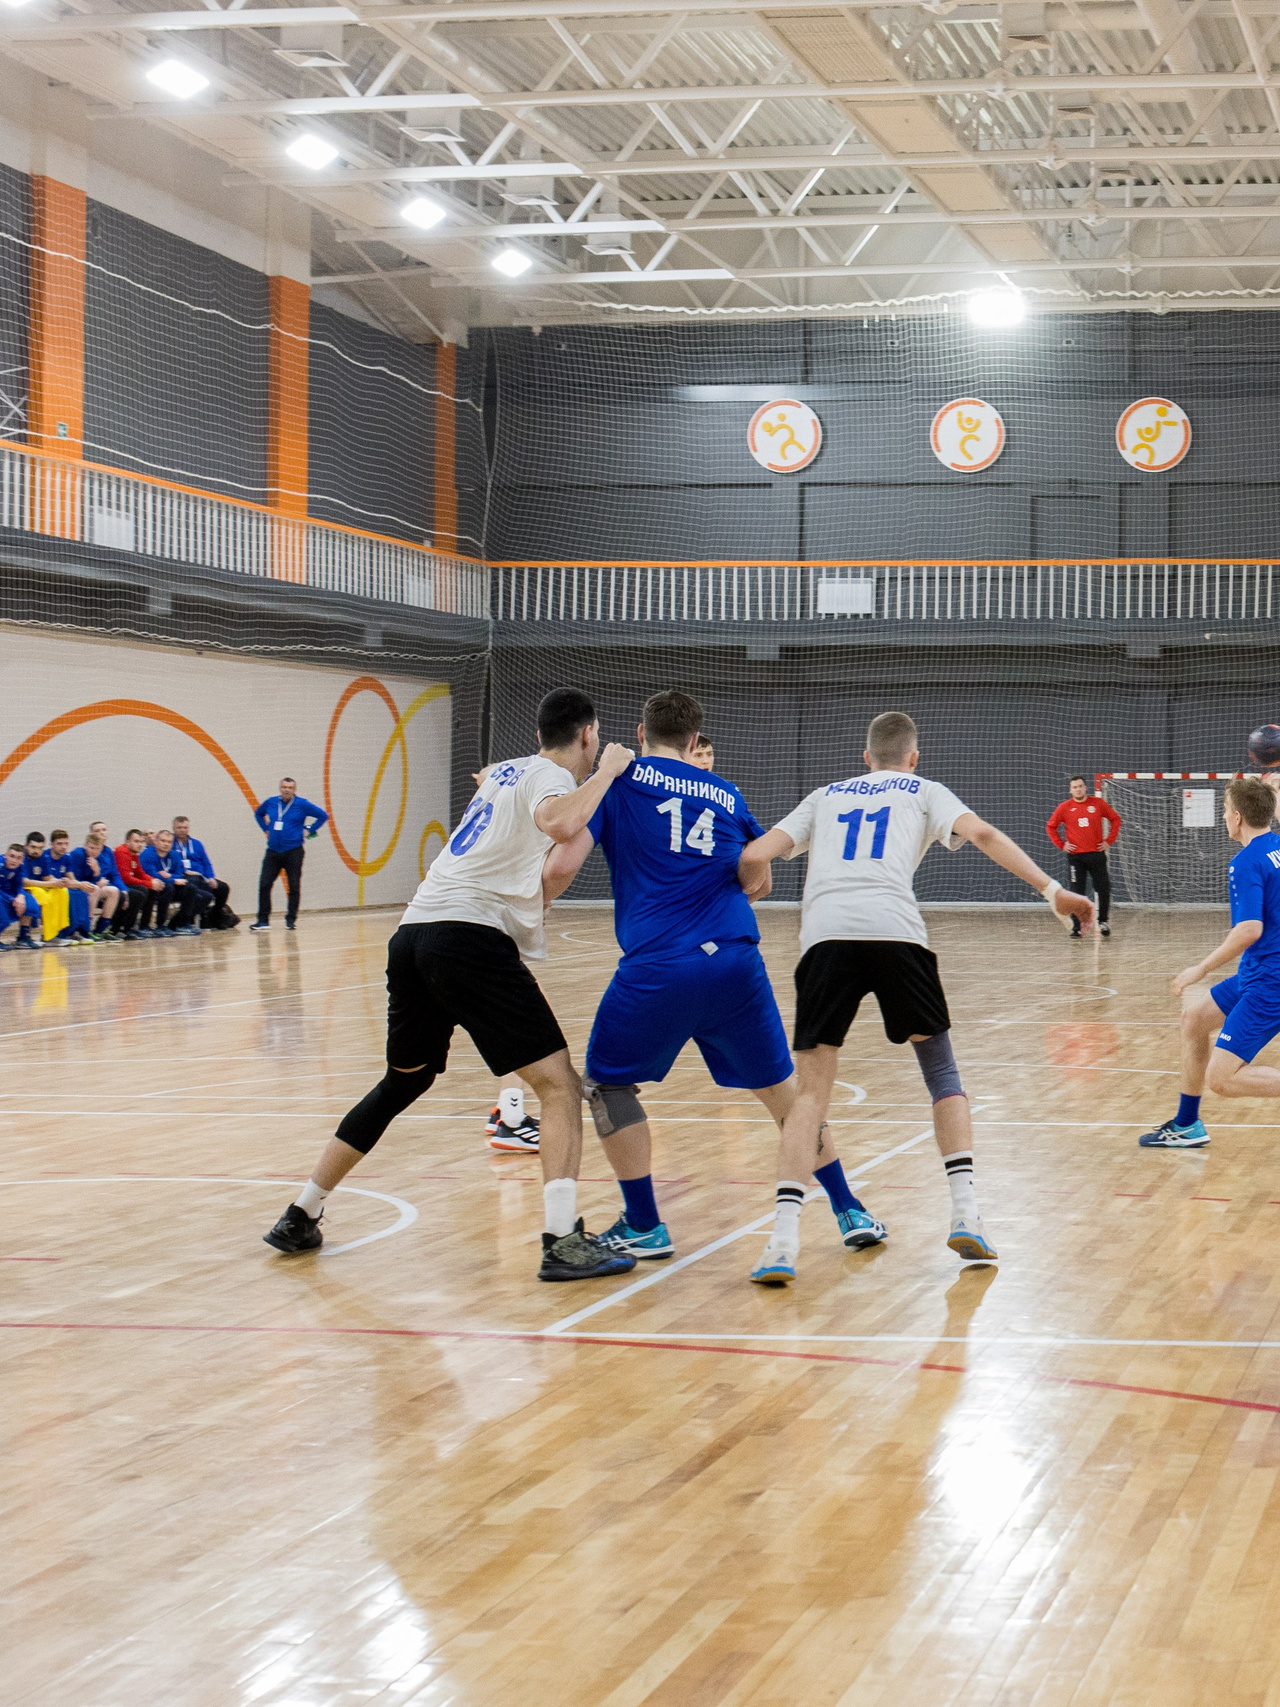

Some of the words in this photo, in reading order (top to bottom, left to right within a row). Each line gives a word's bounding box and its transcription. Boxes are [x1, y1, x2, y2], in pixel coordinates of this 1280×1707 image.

[825, 777, 921, 796] МЕДВЕДКОВ
[656, 797, 716, 856] 14
[838, 806, 891, 861] 11
